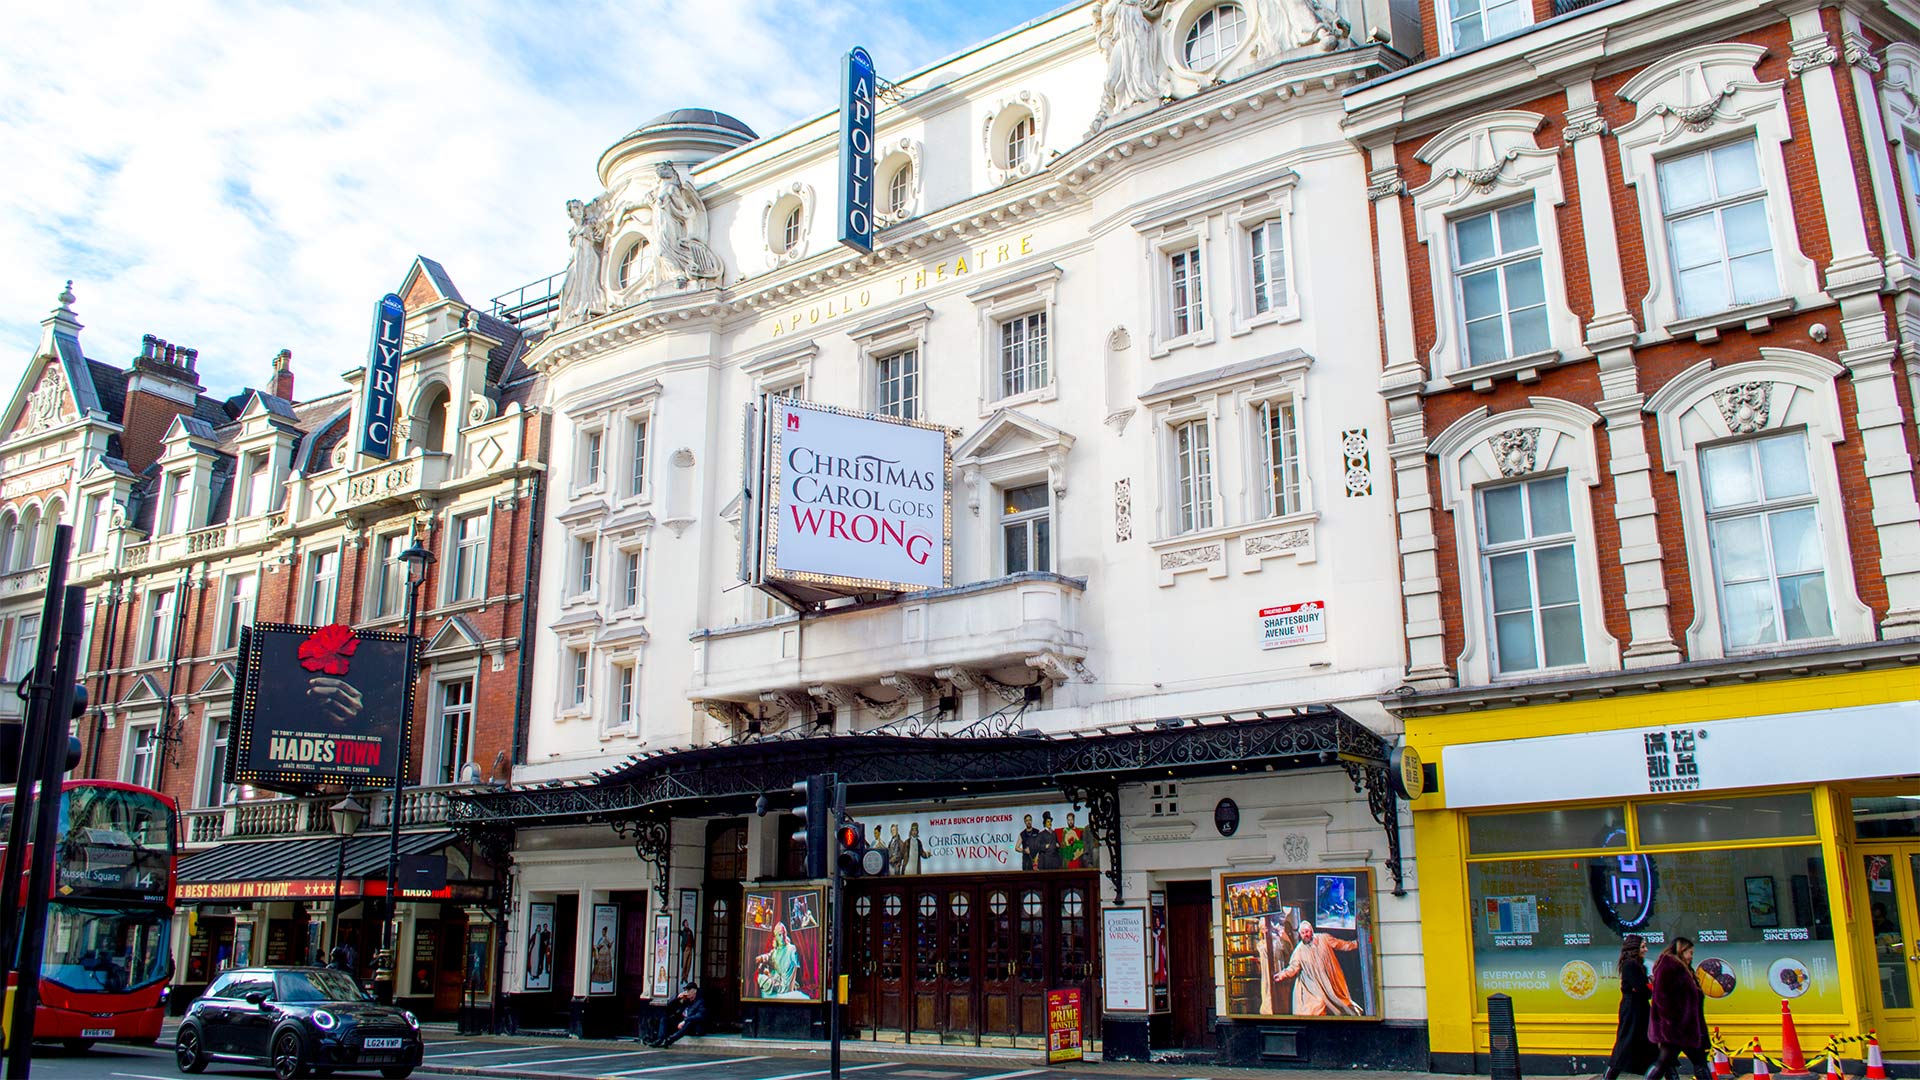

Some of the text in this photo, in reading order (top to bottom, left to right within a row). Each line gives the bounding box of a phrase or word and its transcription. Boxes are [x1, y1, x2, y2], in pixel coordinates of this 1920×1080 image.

[851, 77, 872, 236] APOLLO
[772, 233, 1034, 337] APOLLO THEATRE
[368, 319, 400, 445] LYRIC
[788, 446, 935, 492] CHRISTMAS
[792, 476, 934, 519] CAROL GOES
[790, 504, 934, 566] WRONG
[1264, 613, 1320, 629] SHAFTESBURY
[1265, 624, 1309, 639] AVENUE W1
[269, 737, 381, 766] HADESTOWN
[1649, 777, 1699, 786] HONEYMOON
[930, 817, 947, 826] WHAT
[953, 816, 975, 825] BUNCH
[975, 815, 984, 824] OF
[985, 814, 1013, 823] DICKENS
[928, 833, 1014, 848] CHRISTMAS CAROL
[933, 845, 1009, 864] GOES WRONG
[60, 867, 153, 888] Russell Square 14
[185, 884, 210, 897] BEST
[211, 883, 241, 897] SHOW
[243, 883, 254, 897] IN
[1109, 932, 1139, 943] WRONG
[1764, 932, 1809, 941] SINCE 1995
[1483, 970, 1546, 979] EVERYDAY IS
[1483, 980, 1550, 990] HONEYMOON
[1050, 1008, 1079, 1023] PRIME
[1050, 1020, 1079, 1030] MINISTER
[366, 1039, 385, 1047] LG24
